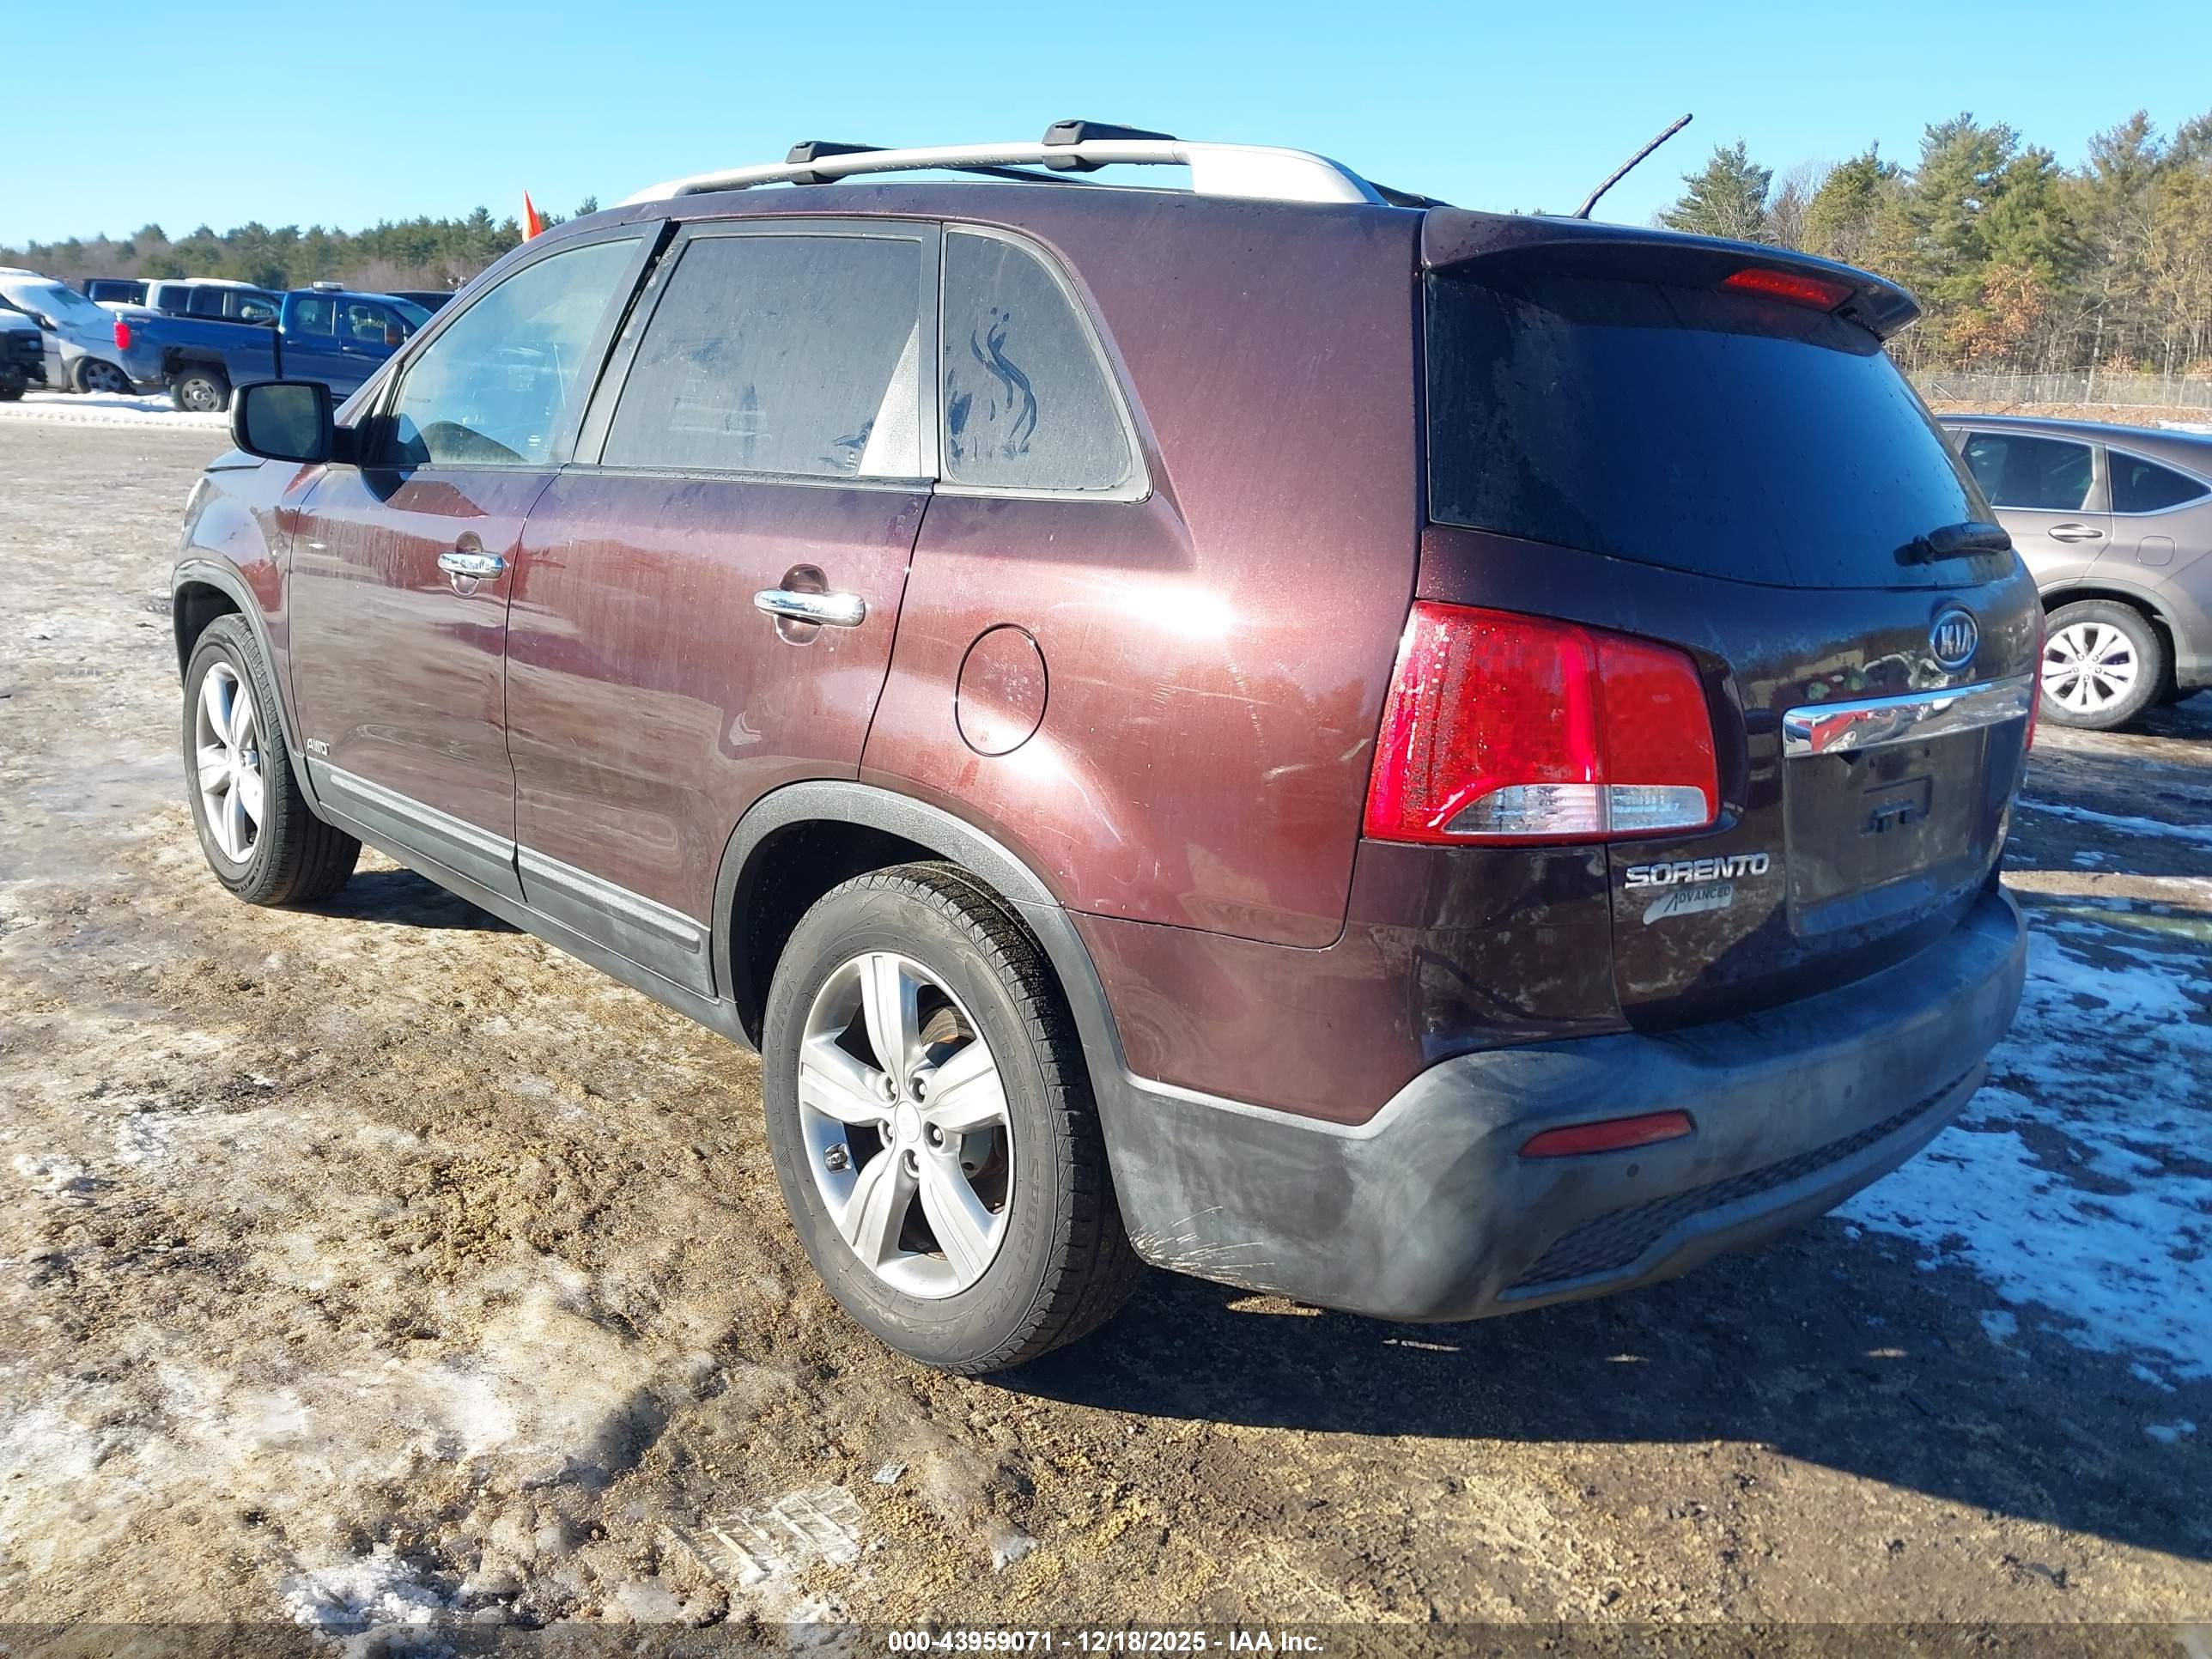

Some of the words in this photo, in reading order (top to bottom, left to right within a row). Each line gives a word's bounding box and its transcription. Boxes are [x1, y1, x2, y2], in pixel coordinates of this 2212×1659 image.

[1940, 623, 1972, 655] KIA
[307, 738, 330, 757] AWD
[1624, 852, 1770, 890] SORENTO
[1663, 884, 1732, 913] ADVANCED
